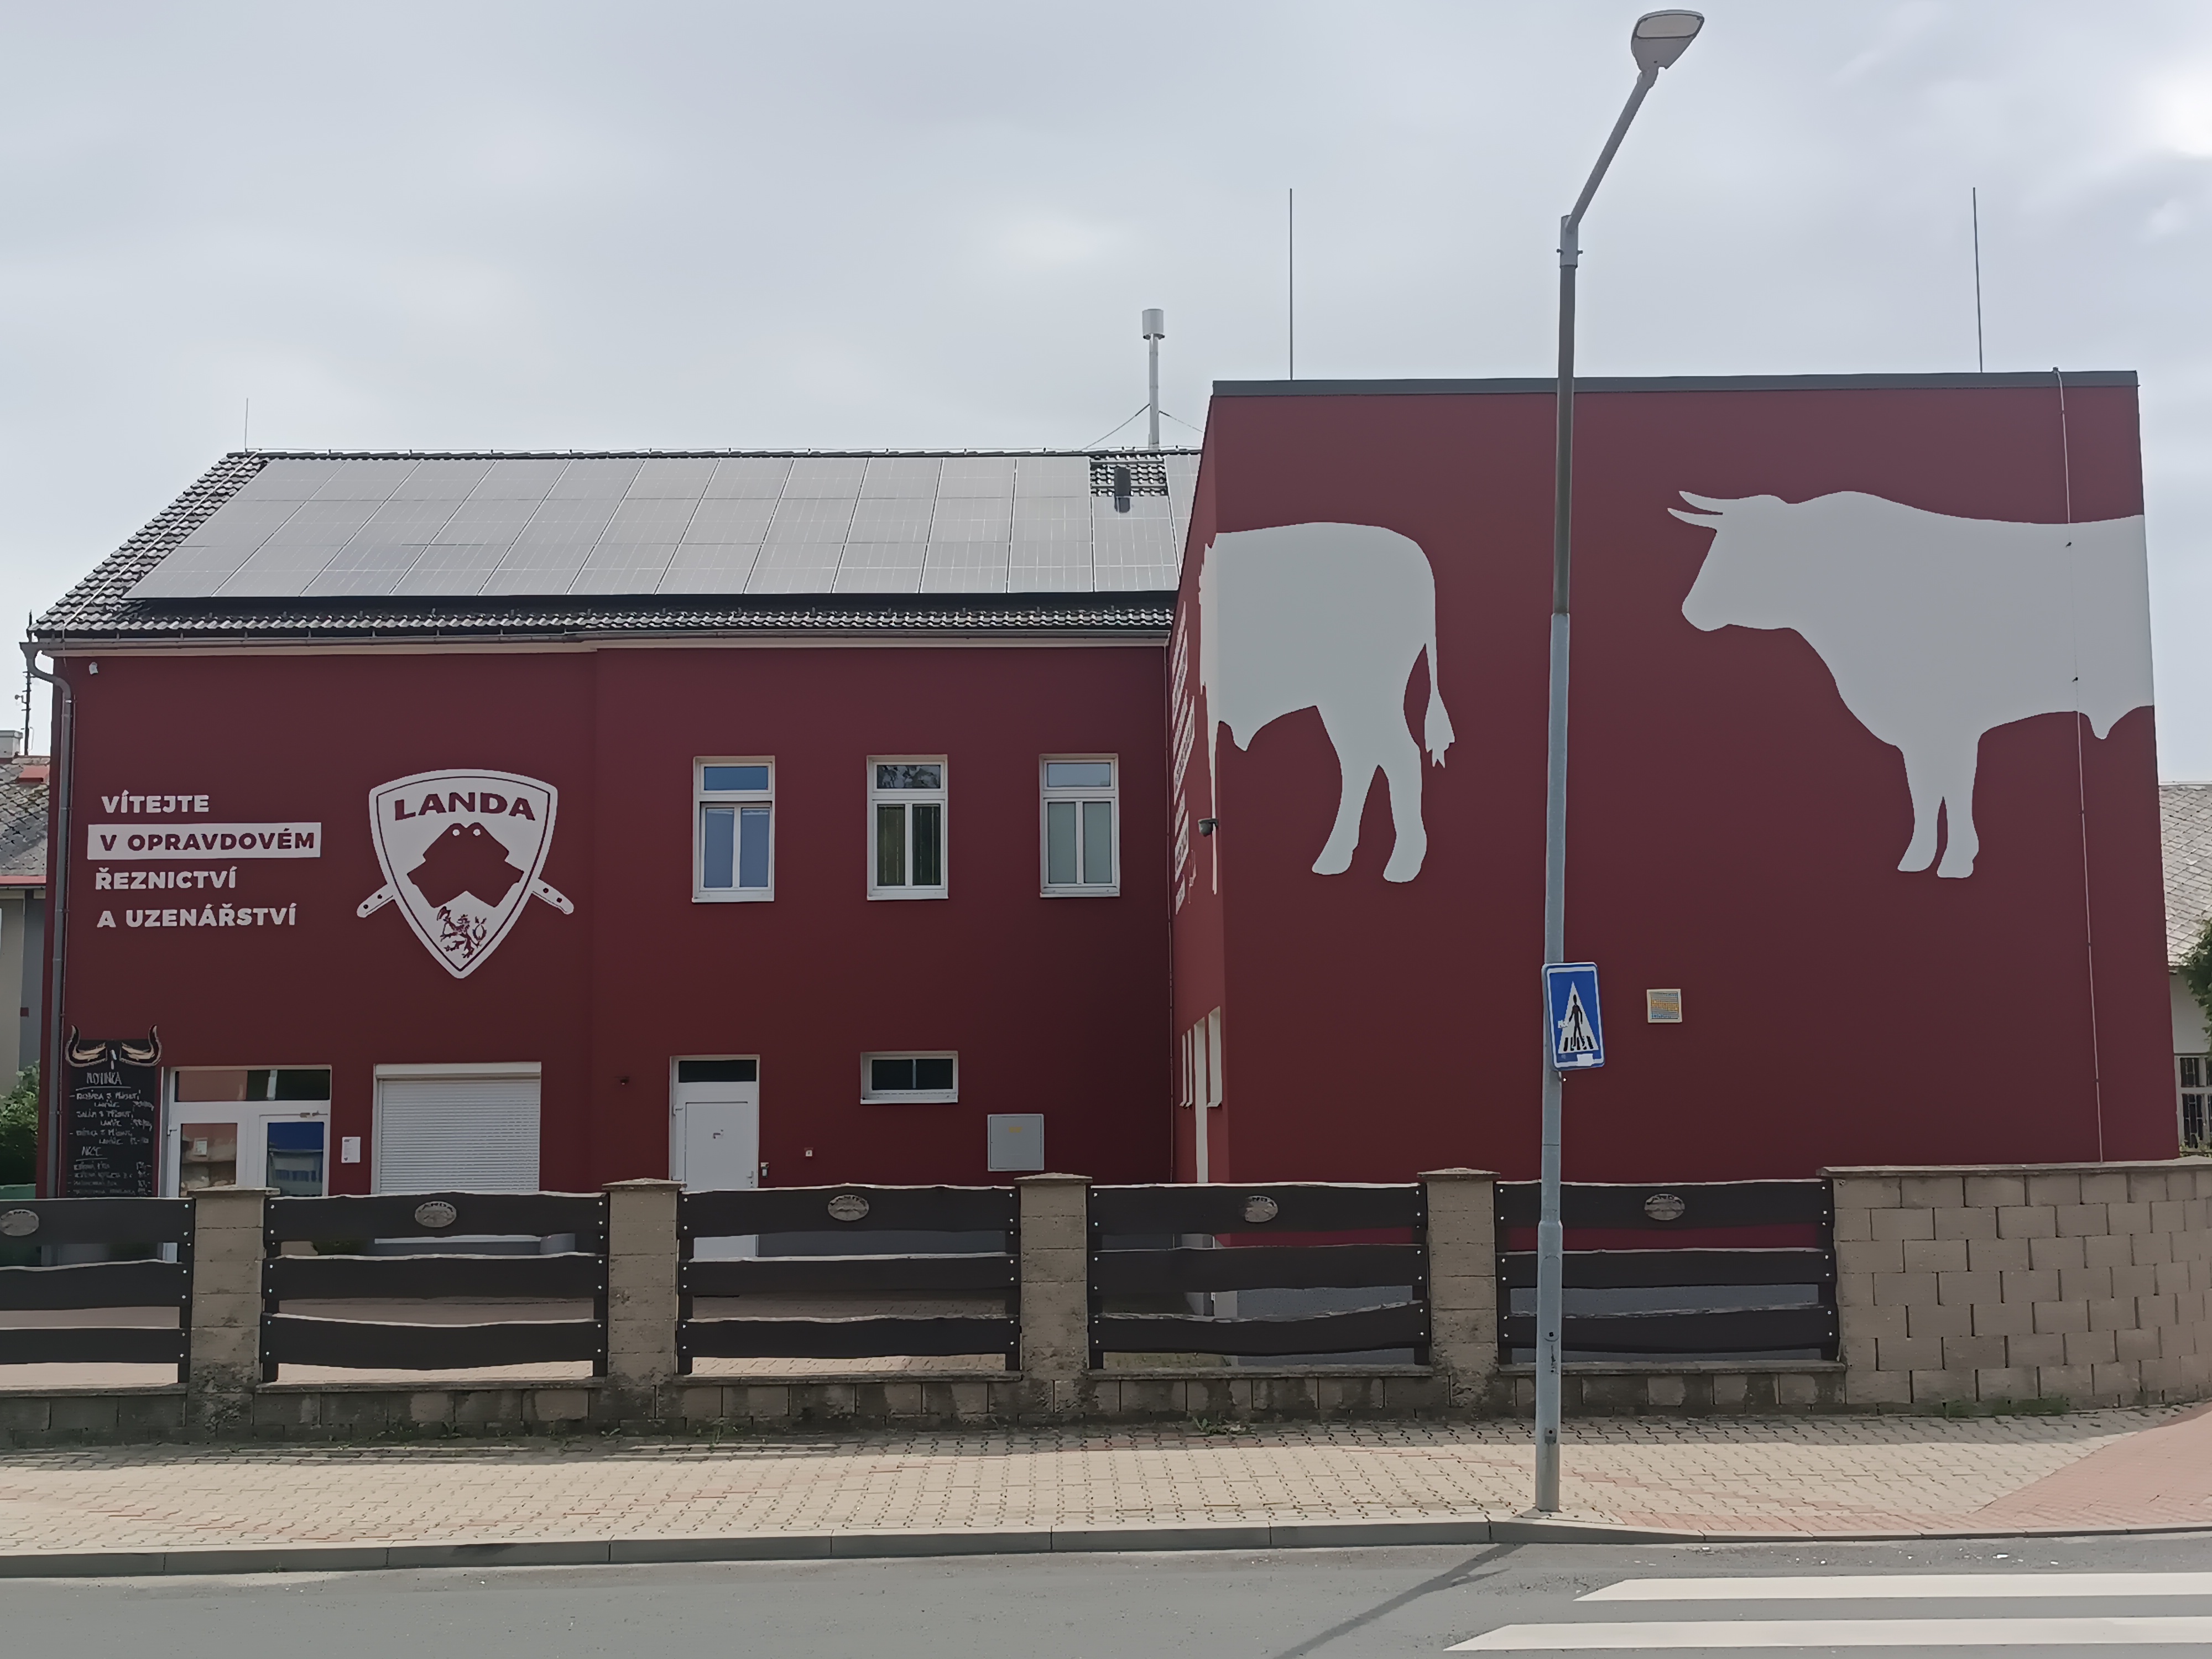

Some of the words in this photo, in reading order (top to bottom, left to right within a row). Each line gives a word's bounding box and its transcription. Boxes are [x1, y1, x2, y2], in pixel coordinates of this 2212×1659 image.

[102, 790, 208, 813] VÍTEJTE
[394, 791, 536, 821] LANDA
[100, 835, 117, 851] V
[128, 828, 314, 851] OPRAVDOVÉM
[96, 866, 237, 890] ŘEZNICTVÍ
[97, 911, 116, 927] A
[126, 903, 296, 927] UZENÁŘSTVÍ
